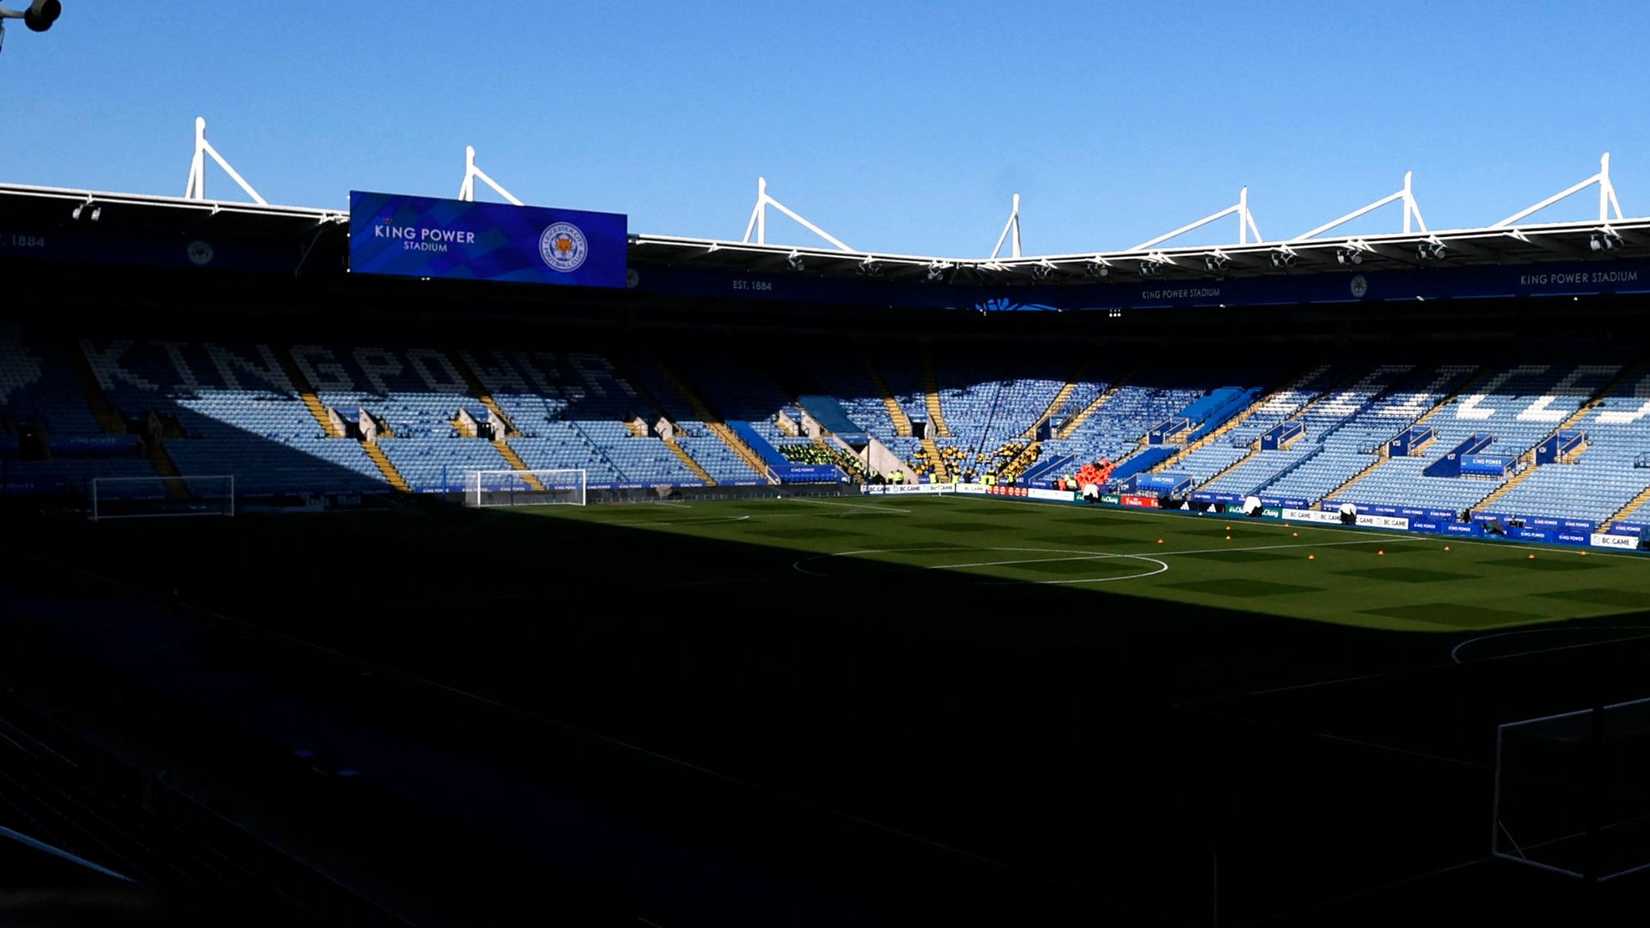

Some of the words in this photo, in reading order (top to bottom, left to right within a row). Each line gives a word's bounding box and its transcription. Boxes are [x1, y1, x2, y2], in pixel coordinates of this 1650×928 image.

[375, 225, 416, 239] KING
[421, 228, 475, 244] POWER
[403, 241, 448, 252] STADIUM
[1521, 274, 1548, 285] KING
[1551, 272, 1589, 284] POWER
[1592, 271, 1638, 282] STADIUM
[1142, 289, 1160, 300] KING
[1163, 288, 1188, 299] POWER
[1190, 287, 1221, 298] STADIUM
